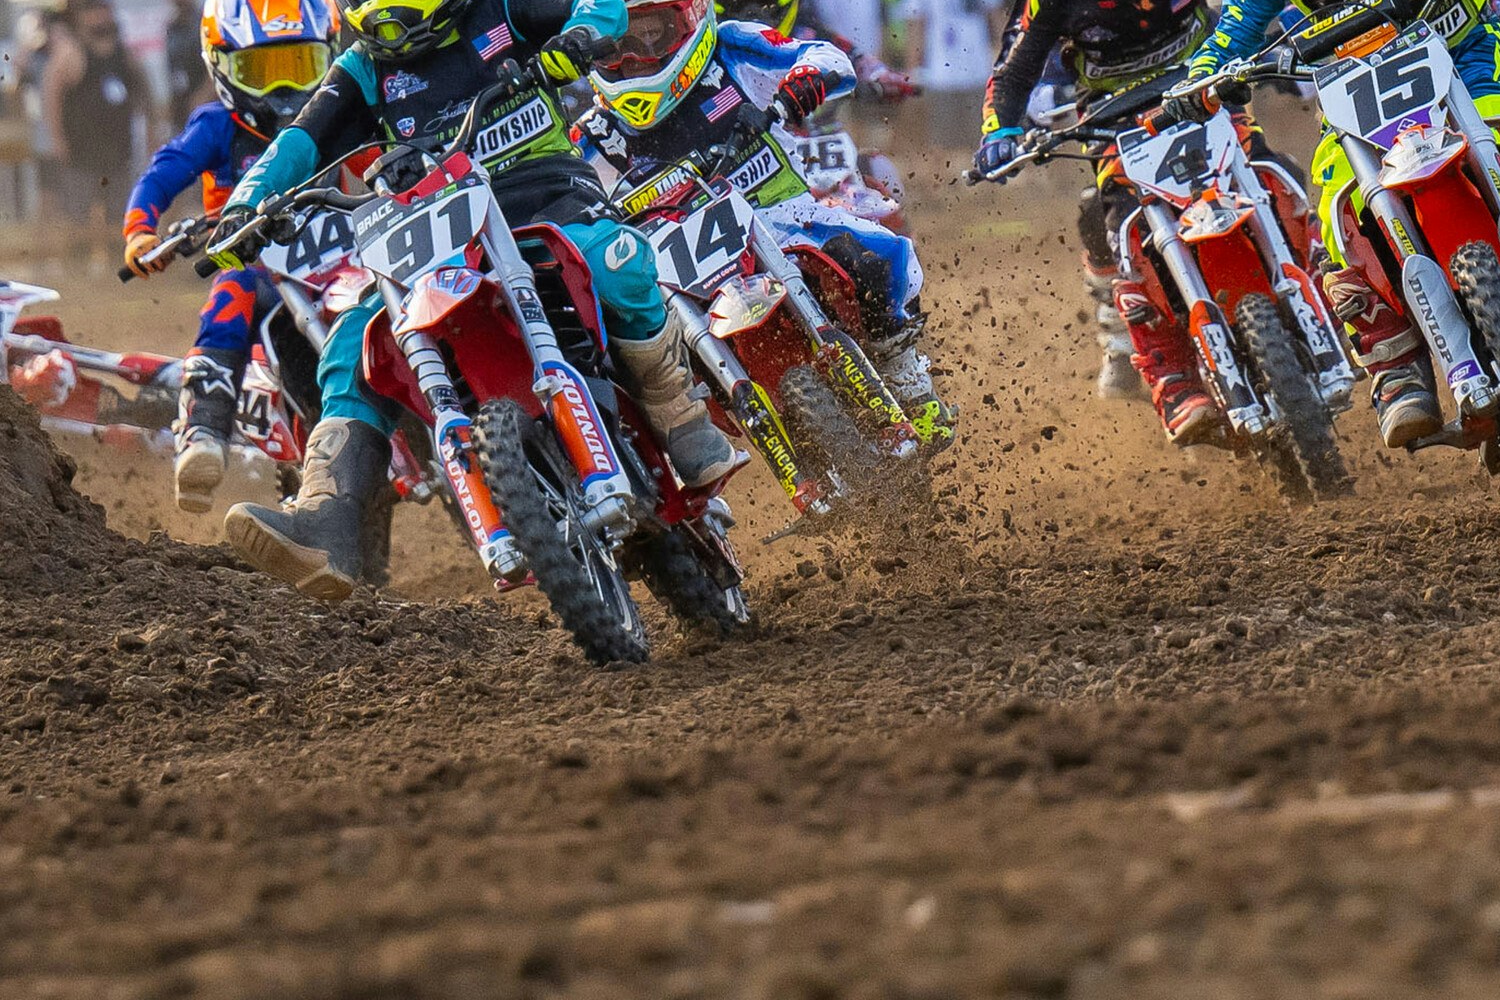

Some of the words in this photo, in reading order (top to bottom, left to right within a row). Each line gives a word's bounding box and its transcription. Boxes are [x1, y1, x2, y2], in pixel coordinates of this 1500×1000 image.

[1344, 46, 1436, 136] 15
[1154, 126, 1213, 185] 4
[285, 211, 354, 274] 44
[356, 199, 396, 236] BRACE
[386, 192, 474, 282] 91
[658, 197, 748, 289] 14
[1408, 277, 1452, 363] DUNLOP
[555, 368, 613, 473] DUNLOP
